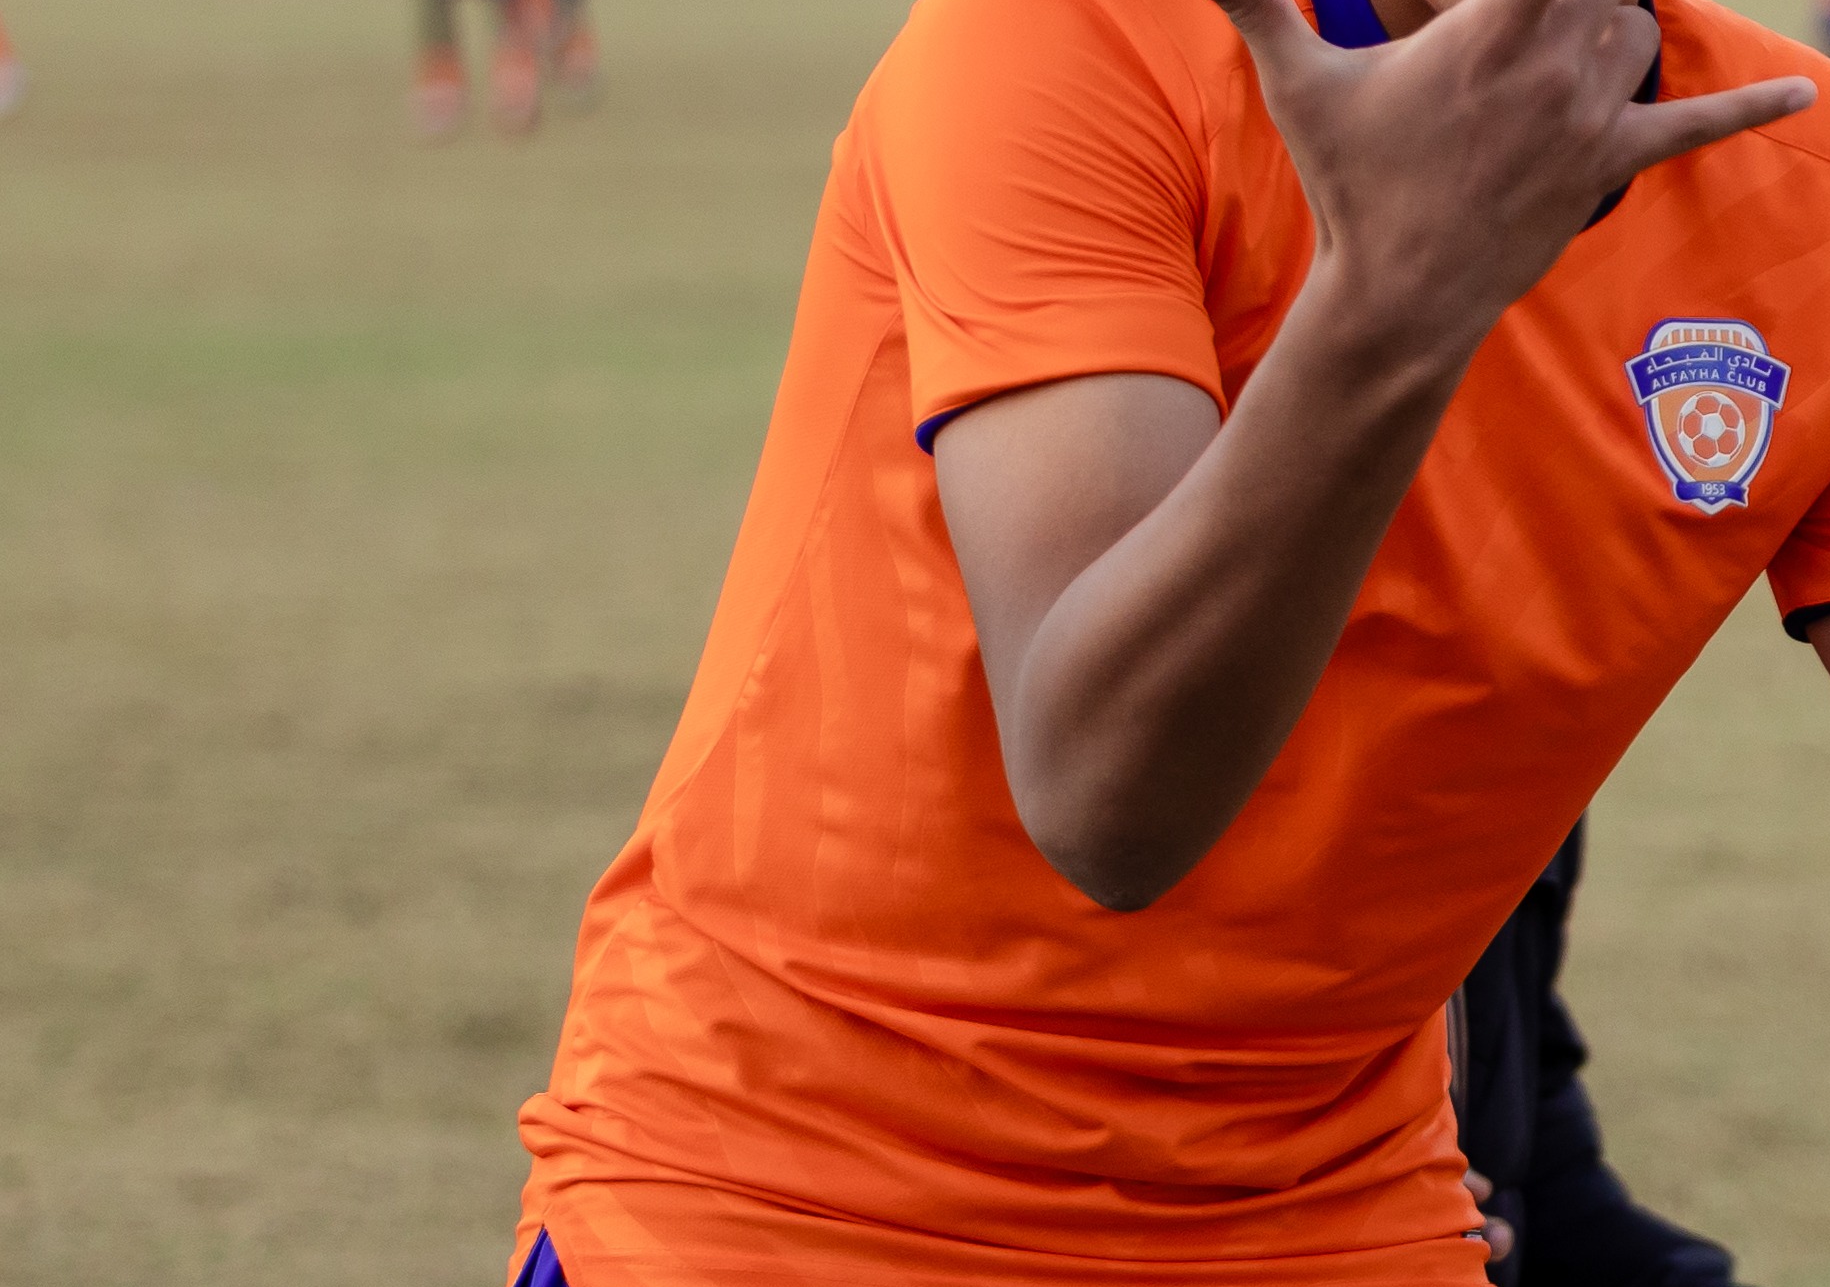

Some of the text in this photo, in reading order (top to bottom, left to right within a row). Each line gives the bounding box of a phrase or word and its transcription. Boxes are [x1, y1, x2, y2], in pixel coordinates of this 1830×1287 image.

[1646, 347, 1774, 378] نادي الفيحاء
[1652, 368, 1766, 393] ALFAYHA CLUB
[1701, 483, 1726, 495] 1953
